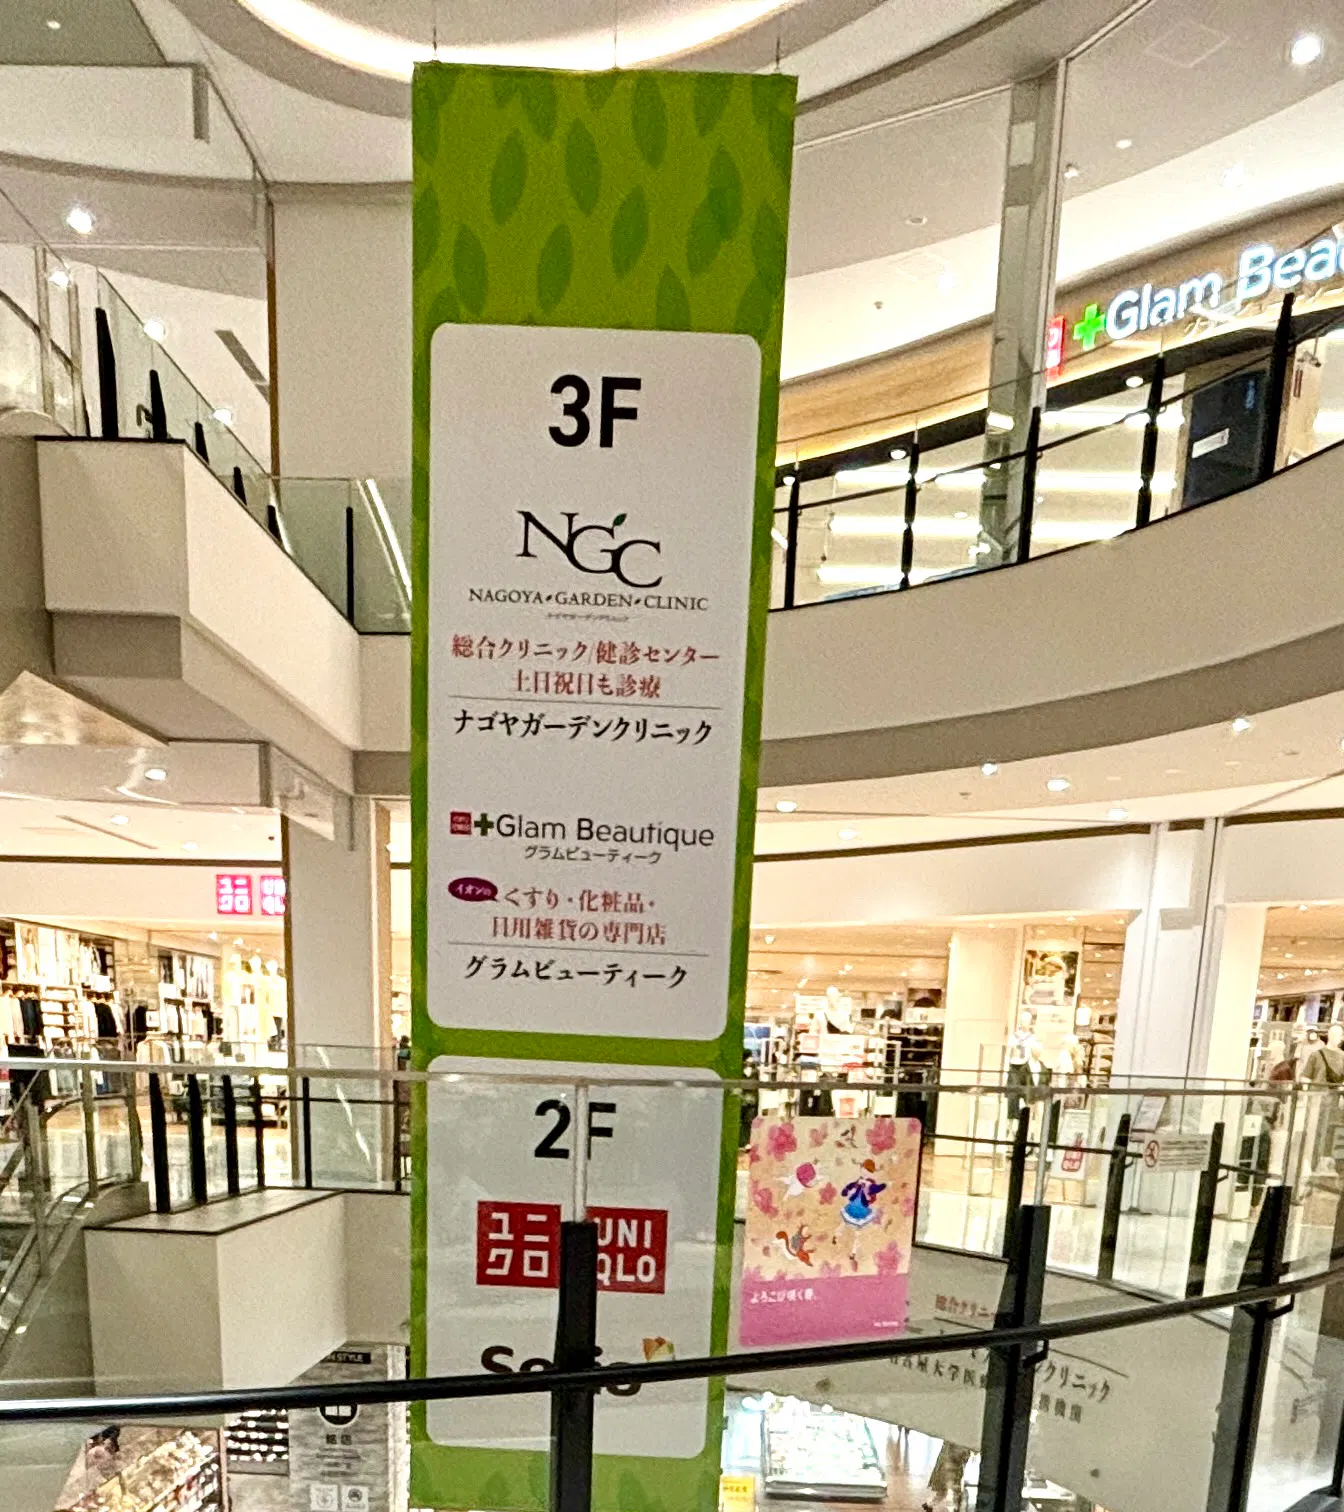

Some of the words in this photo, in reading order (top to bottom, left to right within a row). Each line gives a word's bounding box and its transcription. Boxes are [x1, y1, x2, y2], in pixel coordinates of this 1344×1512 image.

[1105, 272, 1220, 340] Glam
[547, 374, 642, 448] 3F
[515, 510, 662, 588] NGC
[454, 708, 713, 746] ナゴヤガーデンクリニック
[496, 813, 566, 841] Glam
[577, 817, 715, 851] Beautique
[524, 844, 662, 865] グラムビューティーク
[492, 917, 667, 945] 日用雑貨の専門店
[464, 955, 688, 989] グラムビューティーク
[534, 1099, 617, 1160] 2F
